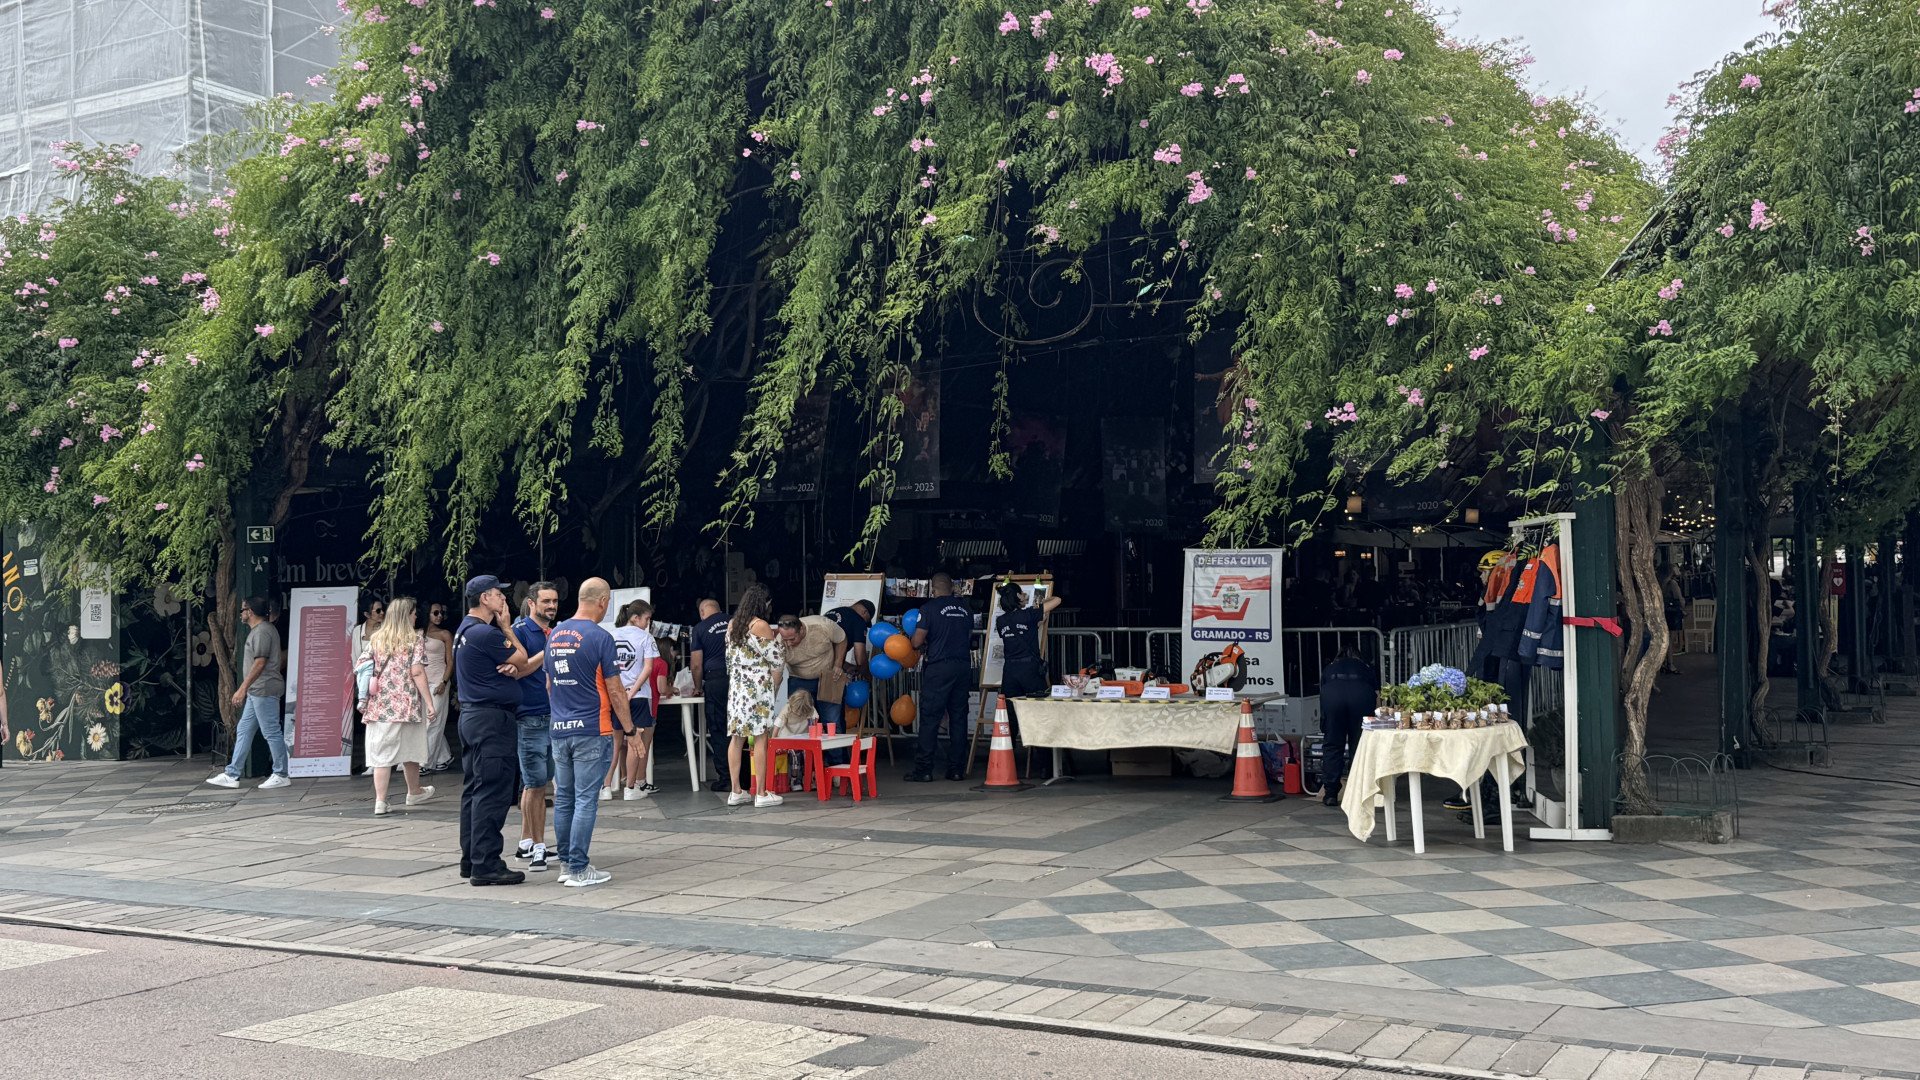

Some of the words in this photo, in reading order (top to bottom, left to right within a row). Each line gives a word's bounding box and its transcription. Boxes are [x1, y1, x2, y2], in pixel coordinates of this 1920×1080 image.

[797, 483, 815, 493] 2022
[914, 482, 935, 492] 2023
[1417, 501, 1438, 511] 2020
[1142, 518, 1164, 527] 2020
[1198, 556, 1237, 565] DEFESA
[1240, 556, 1268, 565] CIVIL
[315, 556, 369, 582] breve
[1194, 630, 1246, 640] GRAMADO
[1255, 631, 1270, 640] RS
[553, 719, 585, 730] ATLETA
